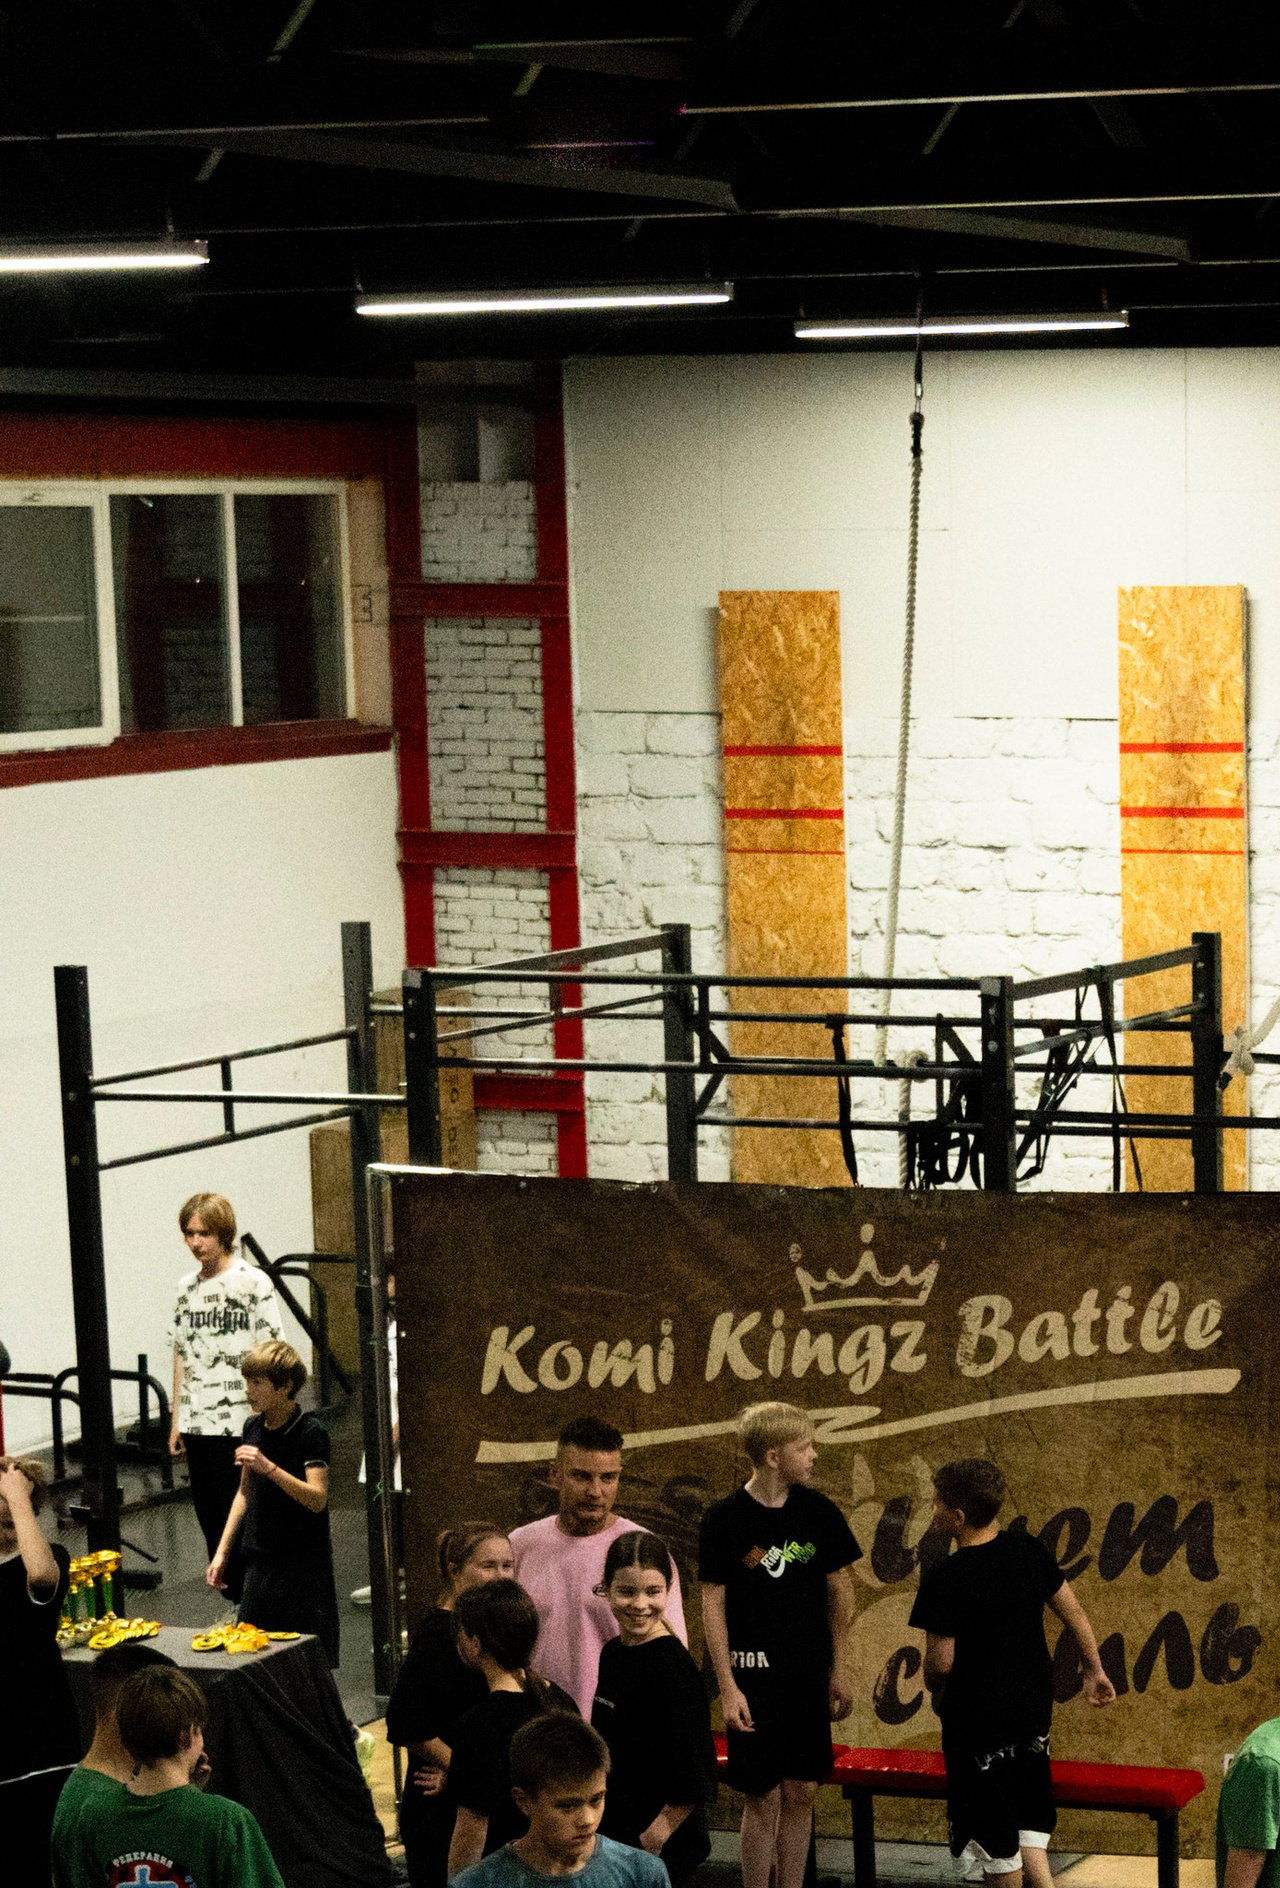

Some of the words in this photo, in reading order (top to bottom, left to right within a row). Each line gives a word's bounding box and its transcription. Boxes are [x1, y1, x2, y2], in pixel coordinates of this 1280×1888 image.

[480, 1319, 676, 1394] Komi
[704, 1308, 928, 1395] Kingz
[956, 1278, 1223, 1378] Battle
